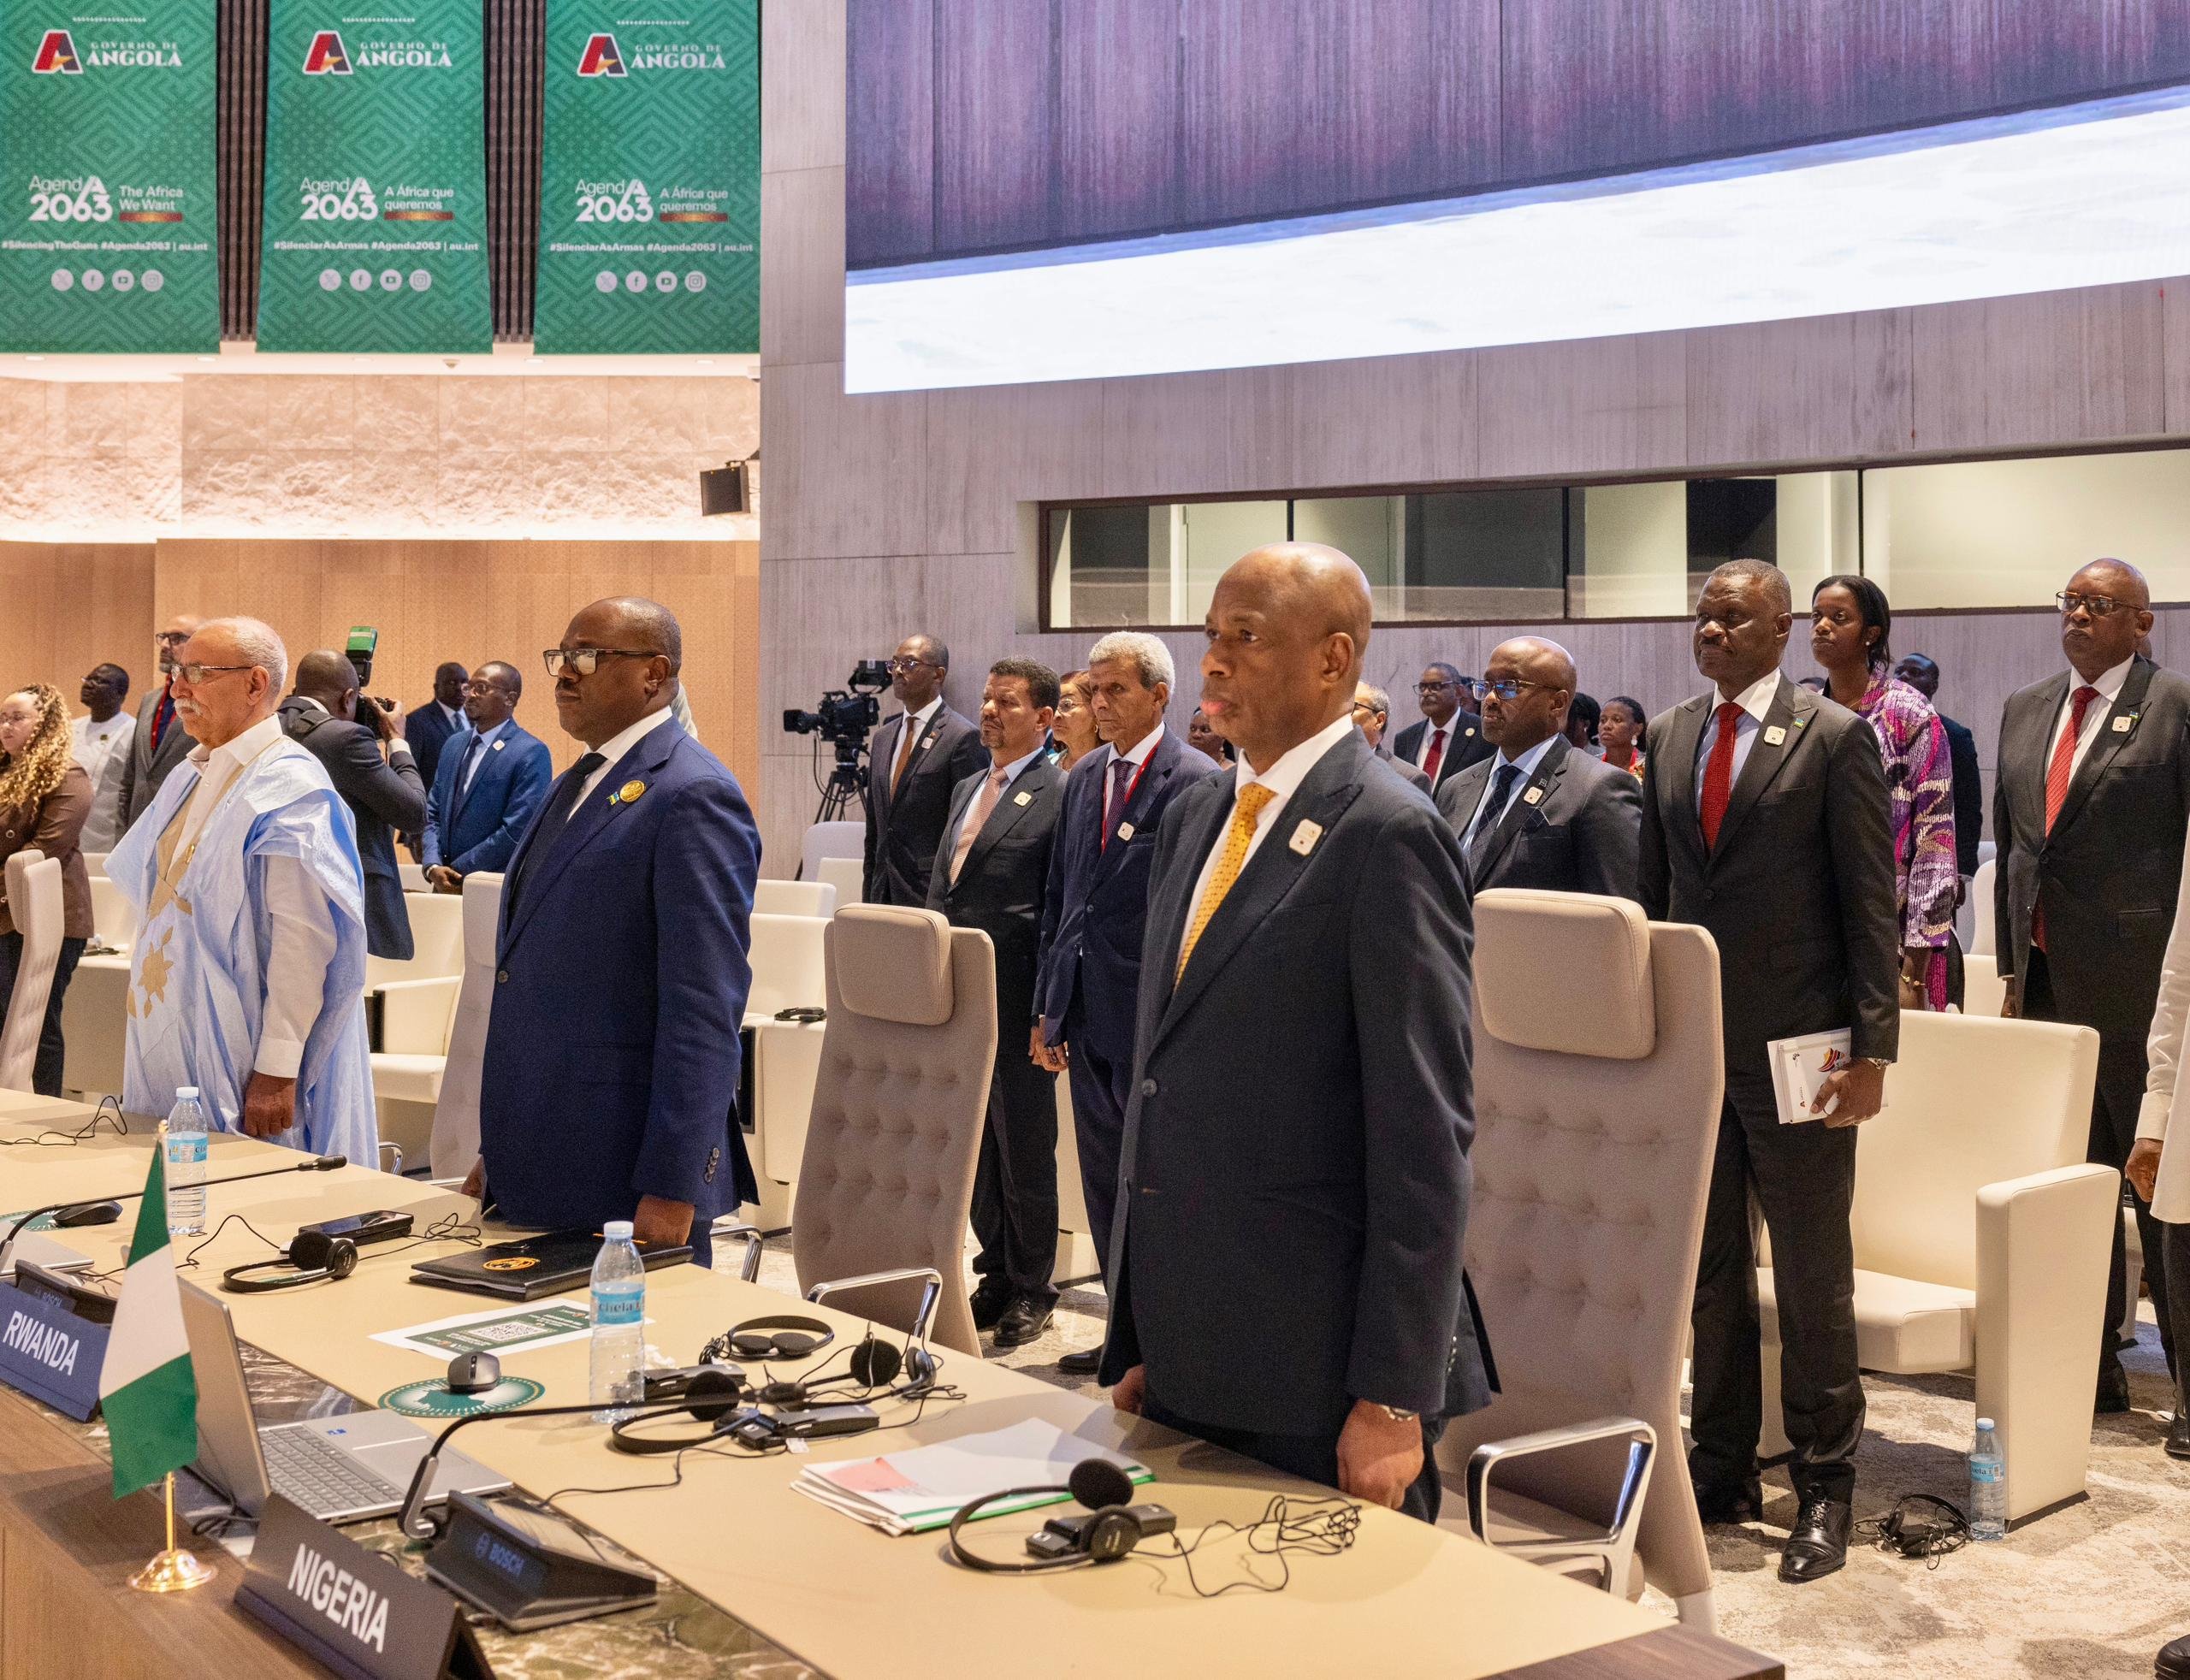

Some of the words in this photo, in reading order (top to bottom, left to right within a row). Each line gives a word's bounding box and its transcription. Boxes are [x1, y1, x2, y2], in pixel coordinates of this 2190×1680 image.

[91, 41, 156, 50] GOVERNO
[86, 50, 182, 67] ANGOLA
[356, 50, 453, 67] ANGOLA
[630, 53, 726, 68] ANGOLA
[119, 185, 144, 198] The
[146, 186, 184, 198] Africa
[385, 186, 394, 197] A
[397, 184, 429, 197] África
[432, 187, 454, 198] que
[660, 187, 669, 198] A
[672, 186, 704, 198] África
[707, 189, 728, 200] que
[28, 192, 113, 222] 2063
[119, 199, 139, 210] We
[142, 199, 175, 210] Want
[299, 193, 379, 221] 2063
[385, 200, 442, 211] queremos
[576, 195, 654, 222] 2063
[660, 202, 717, 212] queremos
[101, 240, 170, 251] #Agenda2063
[371, 240, 441, 251] #Agenda2063
[449, 242, 479, 251] au.int
[647, 242, 715, 253] #Agenda2063
[3, 1310, 80, 1376] RWANDA
[287, 1542, 389, 1653] NIGERIA
